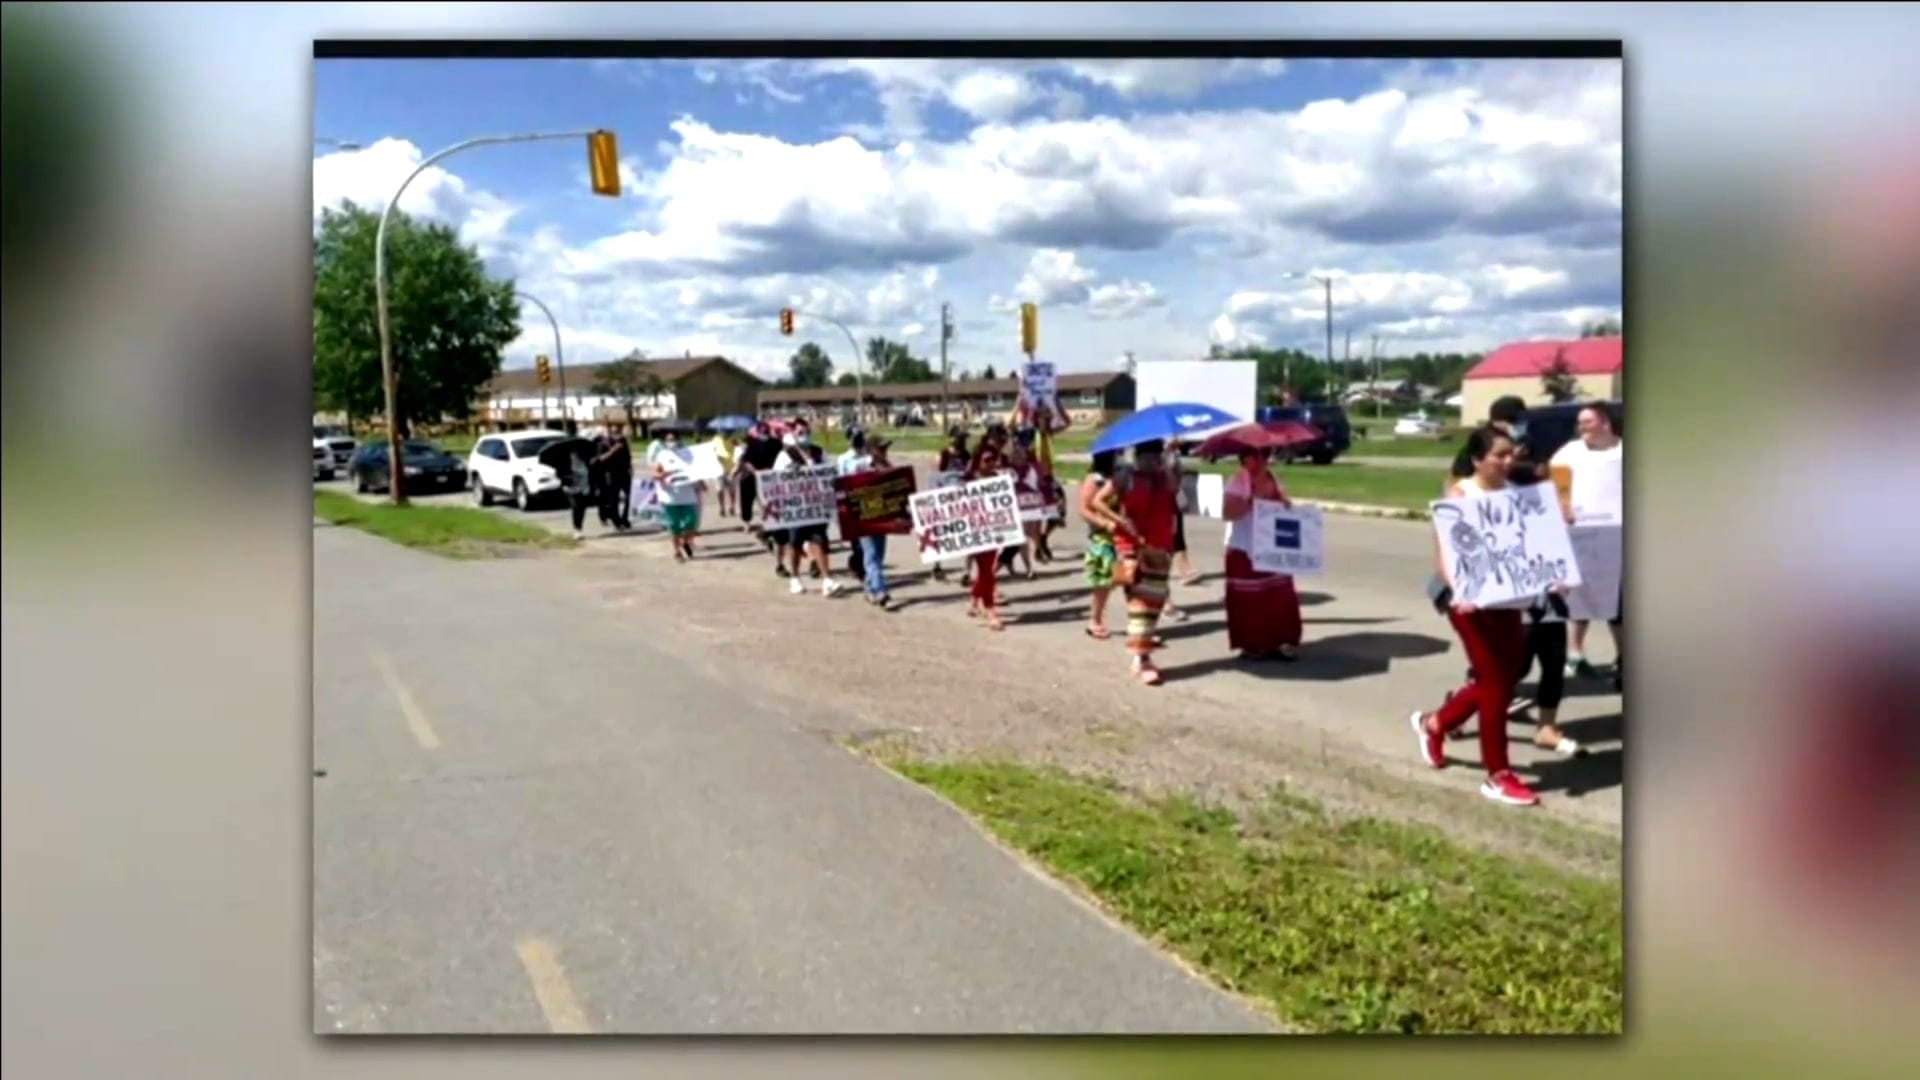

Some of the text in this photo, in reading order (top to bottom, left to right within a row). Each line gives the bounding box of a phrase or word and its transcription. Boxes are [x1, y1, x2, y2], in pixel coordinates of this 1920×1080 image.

[938, 480, 1010, 504] DEMANDS
[918, 498, 986, 527] WALMART
[990, 494, 1013, 509] TO
[932, 508, 1015, 538] END RACIST
[1477, 497, 1503, 530] No
[936, 530, 992, 554] POLICIES
